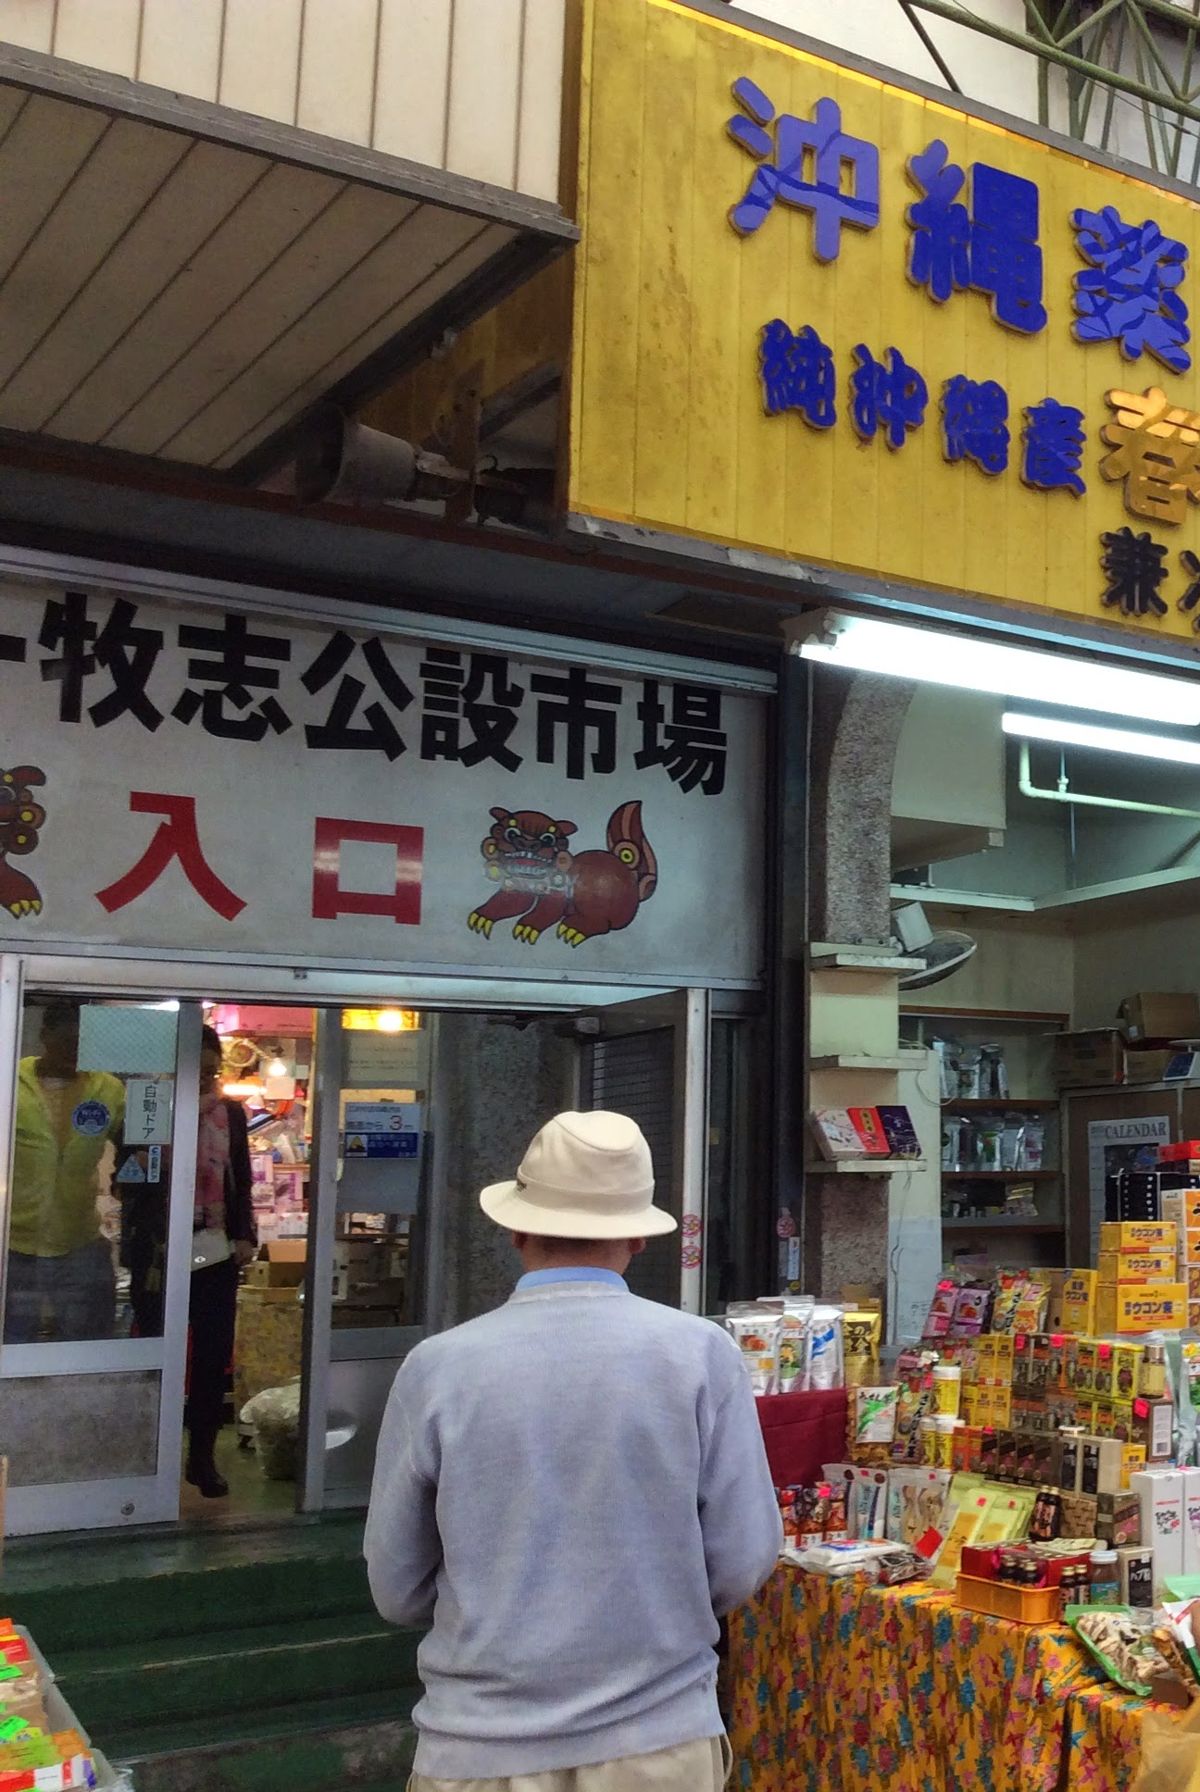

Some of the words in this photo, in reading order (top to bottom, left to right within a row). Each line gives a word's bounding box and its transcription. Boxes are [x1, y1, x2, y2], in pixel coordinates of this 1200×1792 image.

[95, 790, 424, 925] 入口
[142, 1084, 158, 1139] 自動ドア
[1105, 1122, 1166, 1139] CALENDAR
